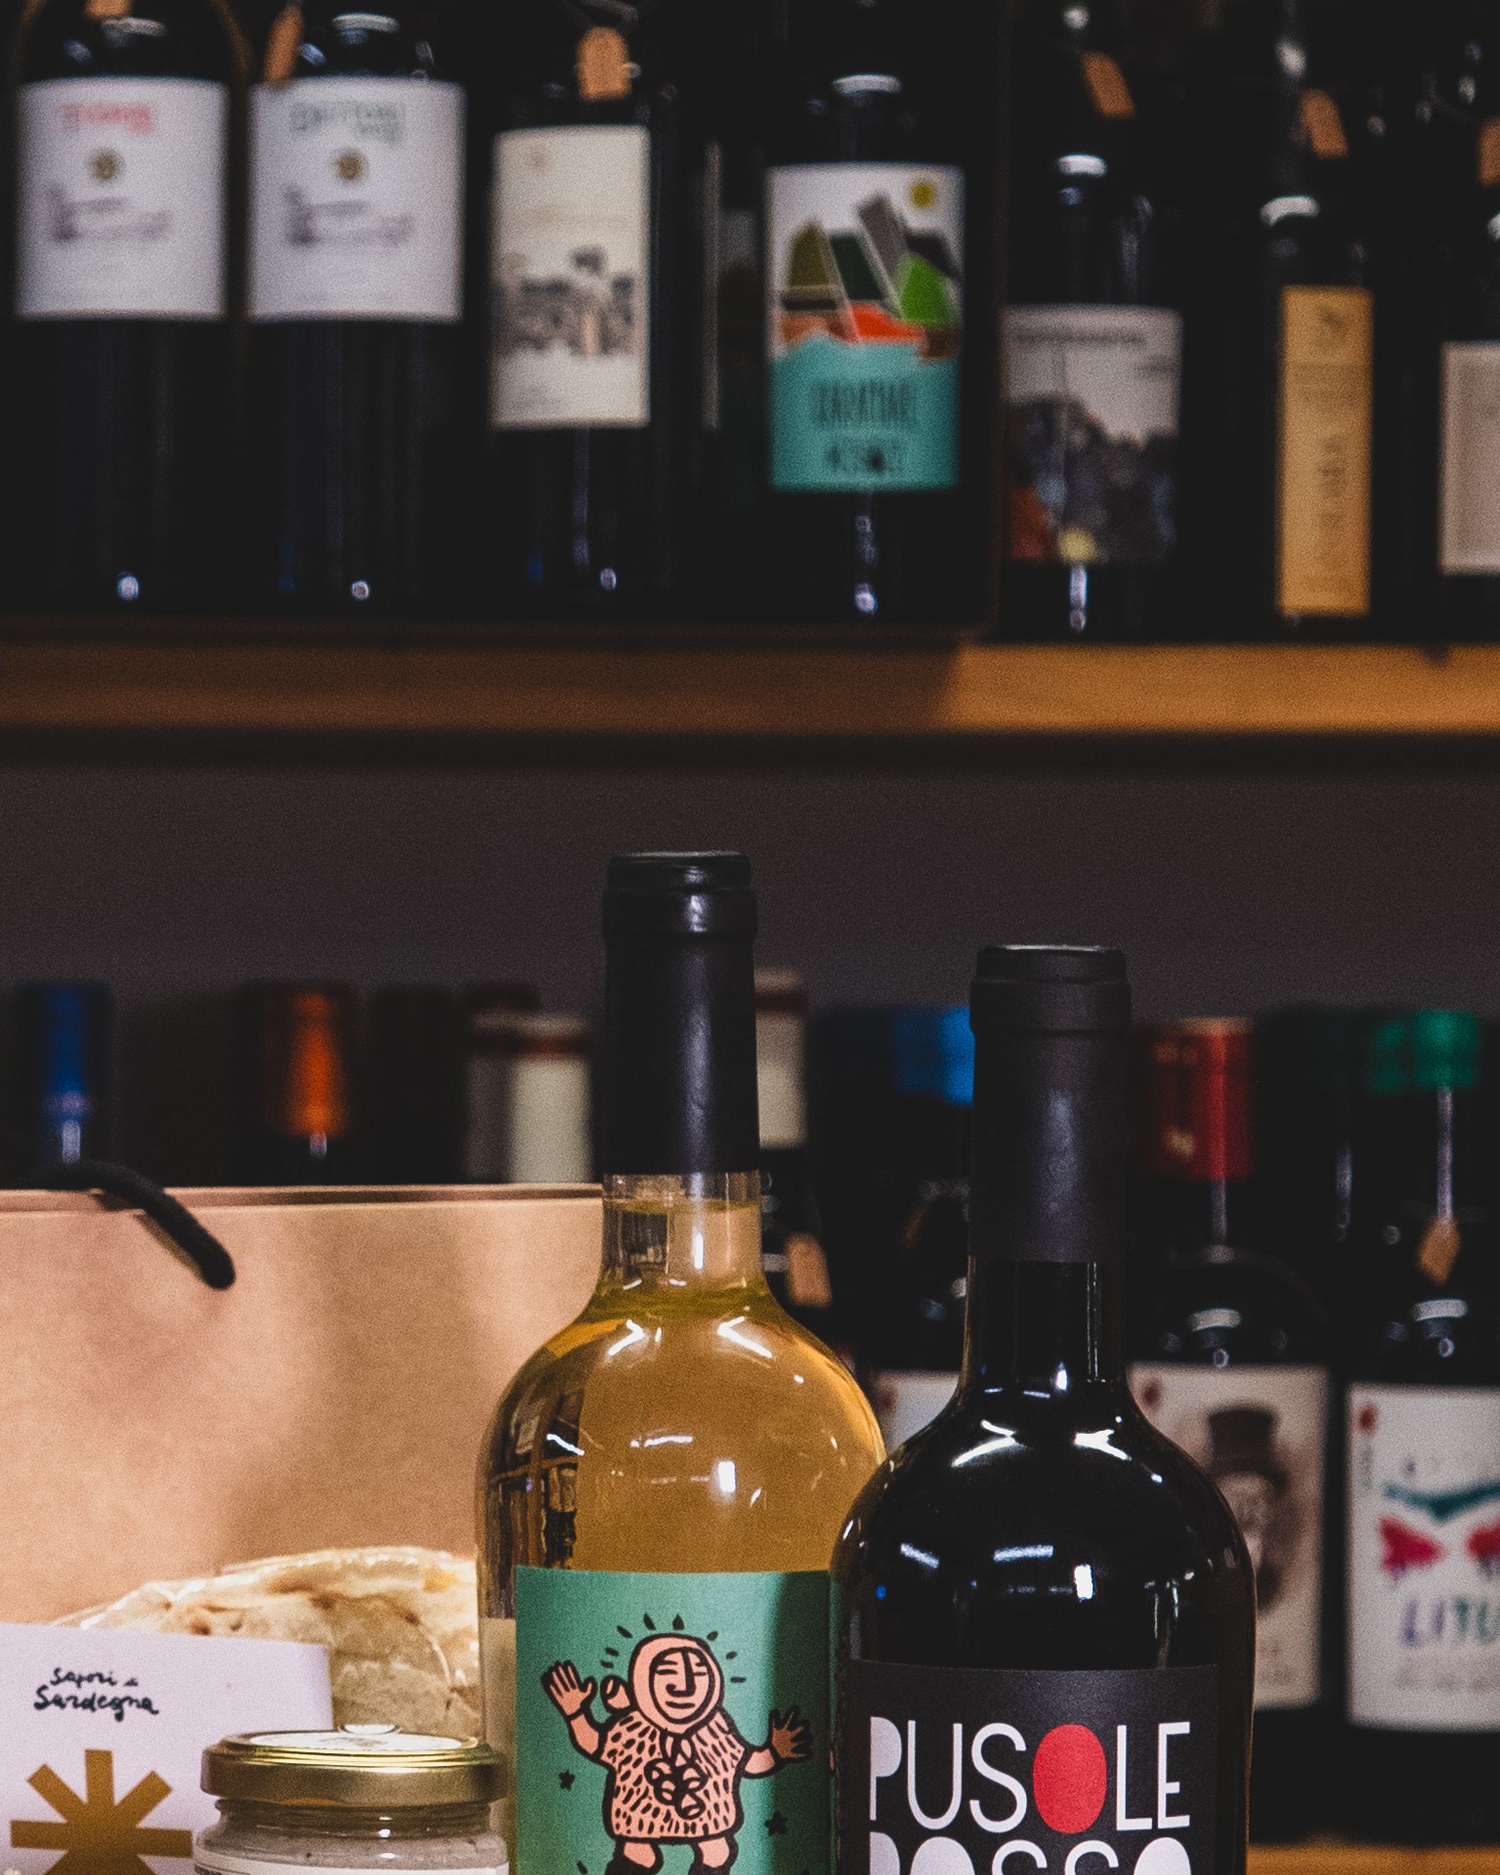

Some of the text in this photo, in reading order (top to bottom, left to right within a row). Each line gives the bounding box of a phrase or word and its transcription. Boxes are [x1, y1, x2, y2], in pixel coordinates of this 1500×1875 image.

[50, 1667, 117, 1689] Sapori
[33, 1684, 159, 1722] Sardegna
[870, 1716, 1191, 1834] PUSOLE
